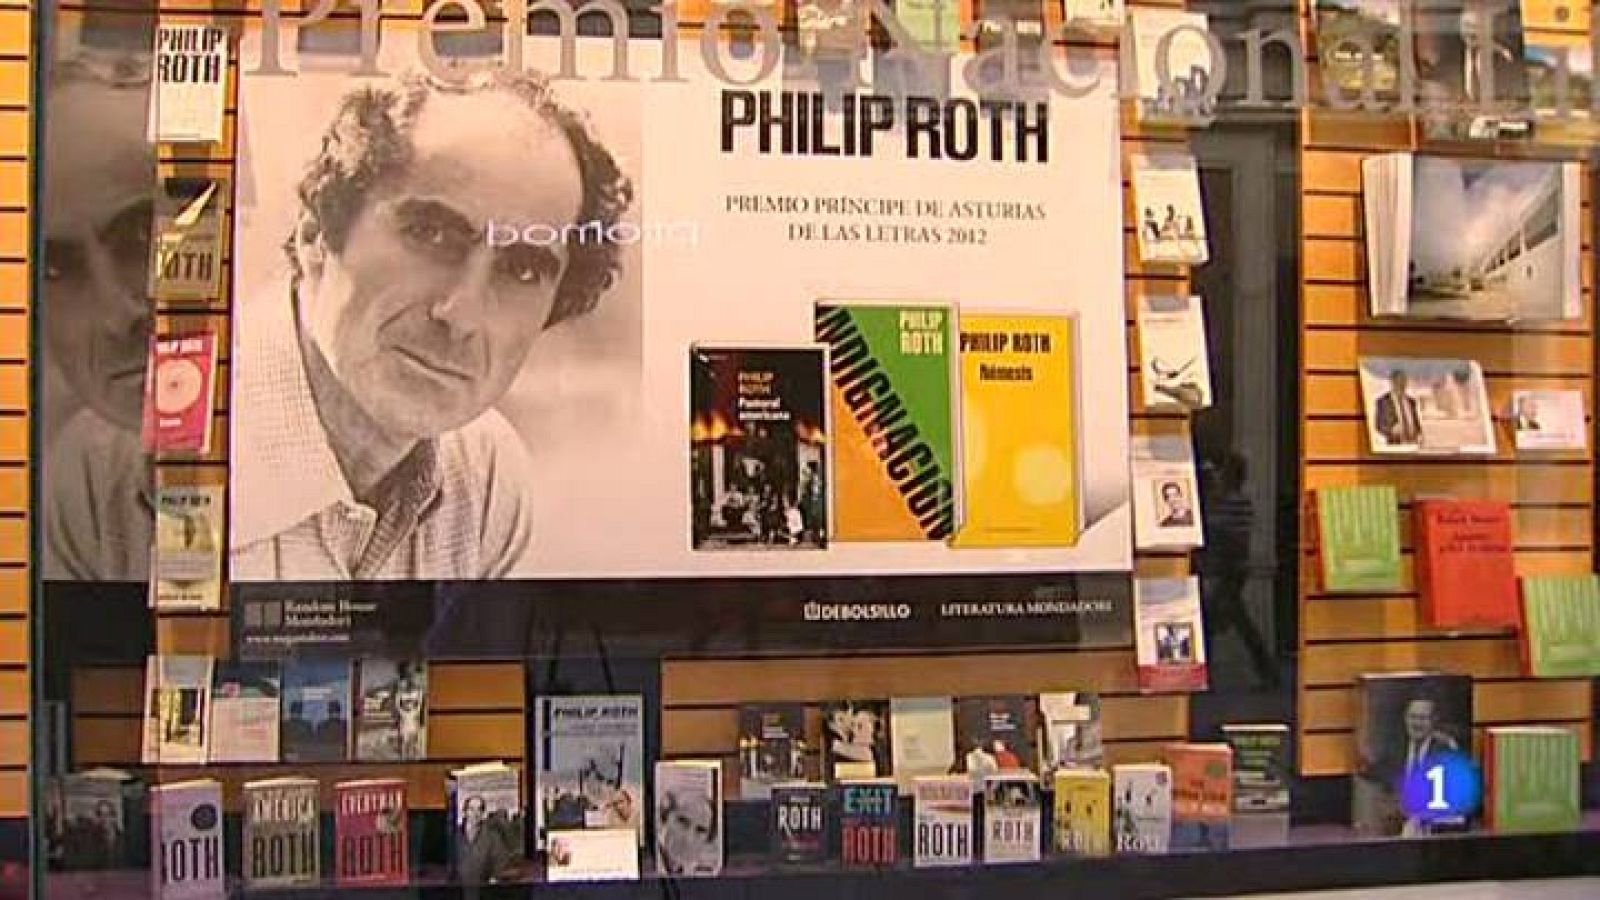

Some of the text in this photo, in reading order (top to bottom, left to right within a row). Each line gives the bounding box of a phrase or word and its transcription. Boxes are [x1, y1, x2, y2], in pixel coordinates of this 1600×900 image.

[158, 28, 223, 52] PHILIP
[158, 54, 221, 83] ROTH
[244, 0, 782, 86] Premio
[832, 0, 1425, 118] Nacional
[720, 90, 1049, 163] PHILIP ROTH
[726, 194, 1047, 221] PREMIO PRÍNCIPE DE ASTURIAS
[788, 223, 988, 246] DE LAS LETRAS 2012
[901, 331, 943, 354] ROTH
[959, 332, 1052, 354] PHILIP ROTH
[822, 603, 911, 620] DEBOLSILLO
[778, 804, 822, 837] ROTH
[992, 820, 1034, 842] ROTH
[253, 831, 315, 879] ROTH
[341, 831, 403, 878] ROTH
[841, 824, 897, 866] ROTH
[918, 823, 968, 858] ROTH
